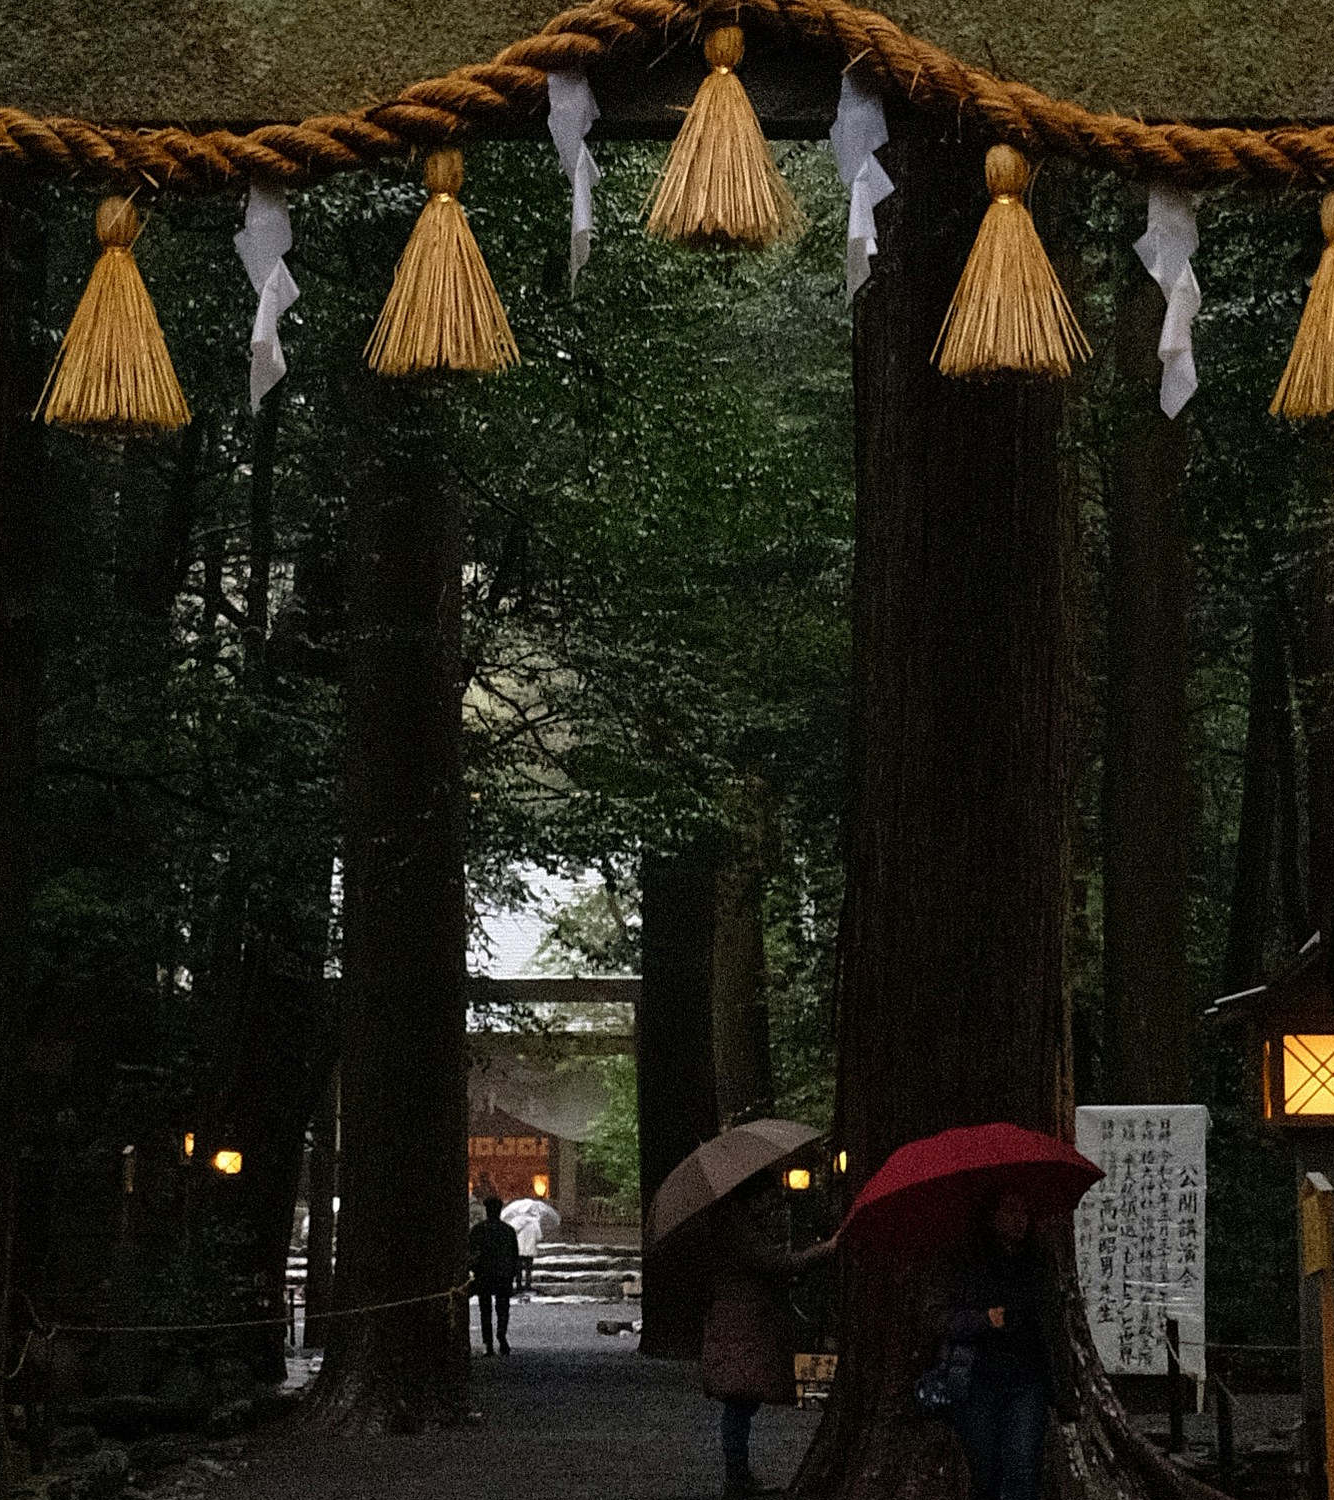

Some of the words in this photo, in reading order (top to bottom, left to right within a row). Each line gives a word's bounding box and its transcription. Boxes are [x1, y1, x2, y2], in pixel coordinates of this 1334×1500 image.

[1178, 1165, 1199, 1290] 公開講演会
